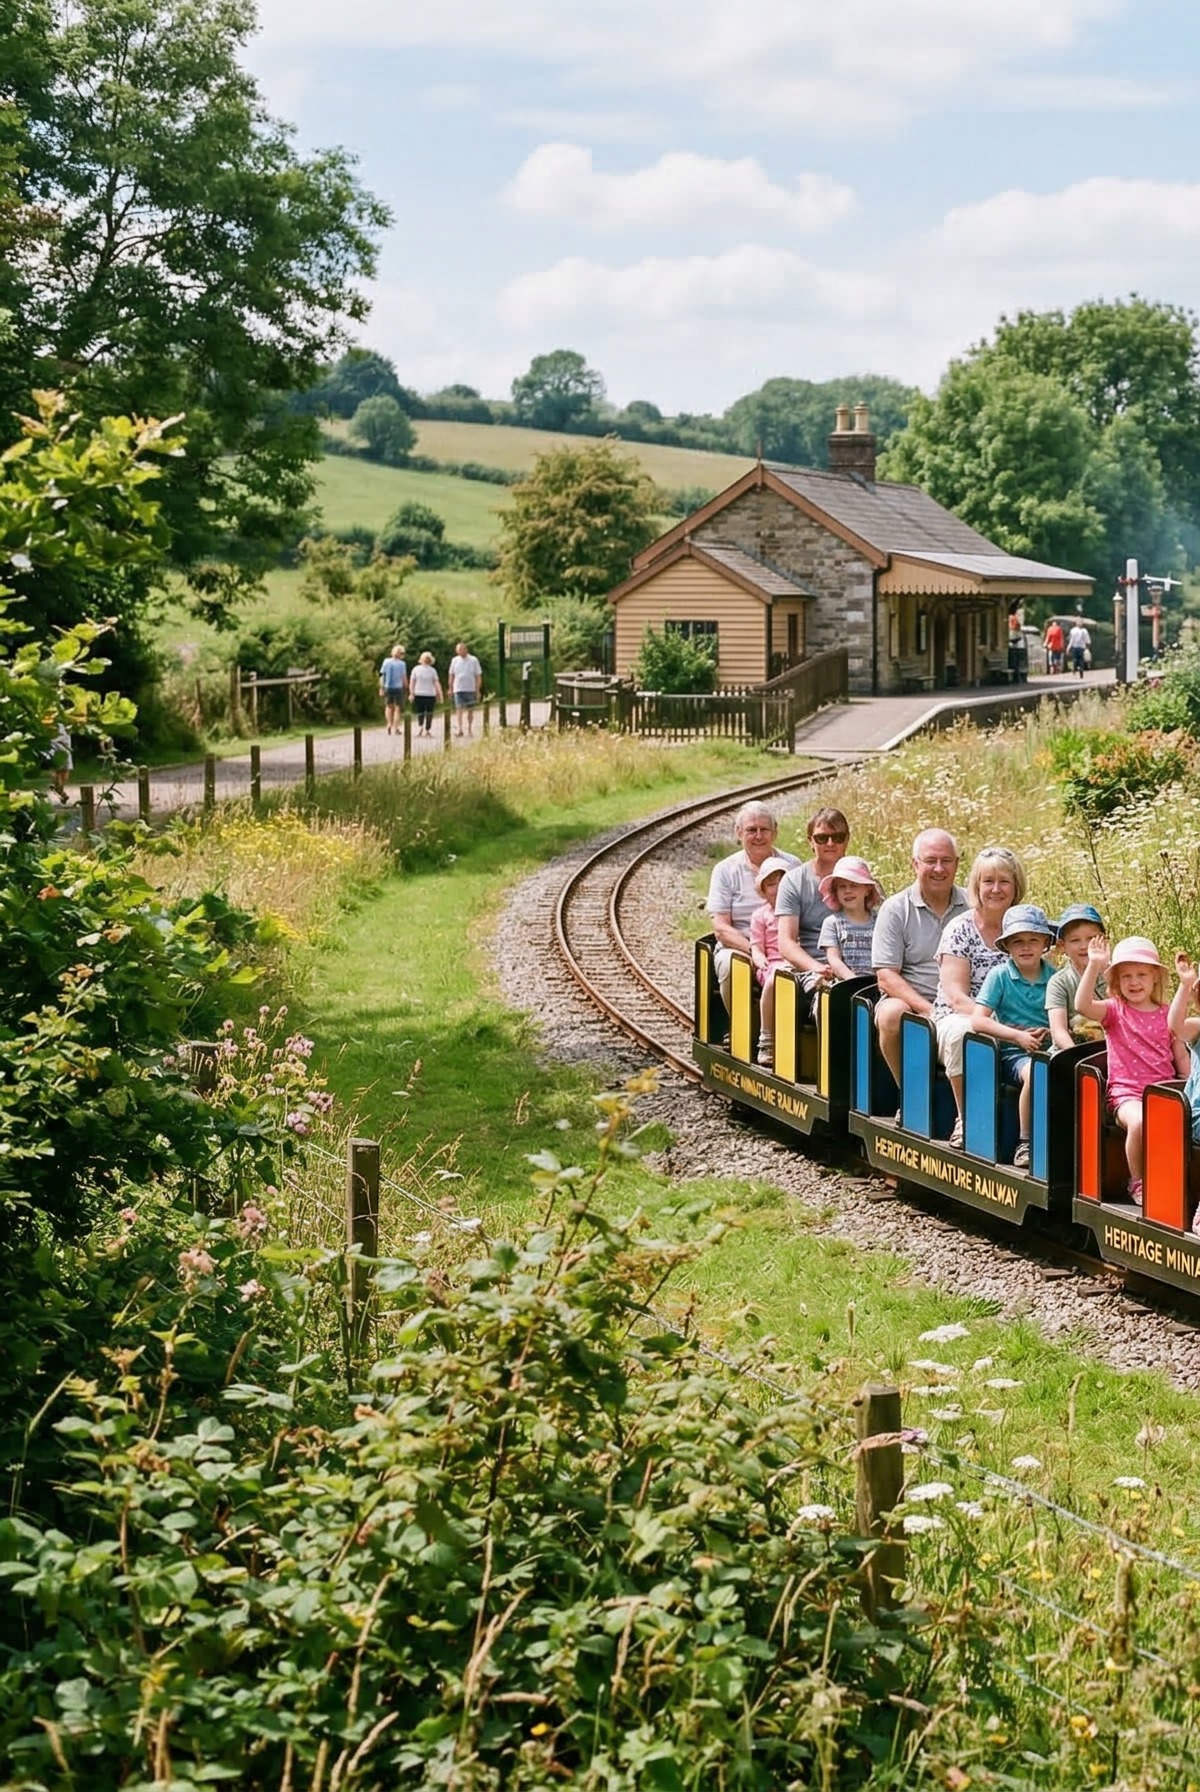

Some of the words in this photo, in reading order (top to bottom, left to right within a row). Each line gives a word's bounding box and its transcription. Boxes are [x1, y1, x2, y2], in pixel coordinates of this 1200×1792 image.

[875, 1135, 919, 1169] HERITAGE
[920, 1153, 973, 1191] MINIATURE
[974, 1174, 1019, 1208] RAILWAY
[1104, 1225, 1163, 1265] HERITAGE
